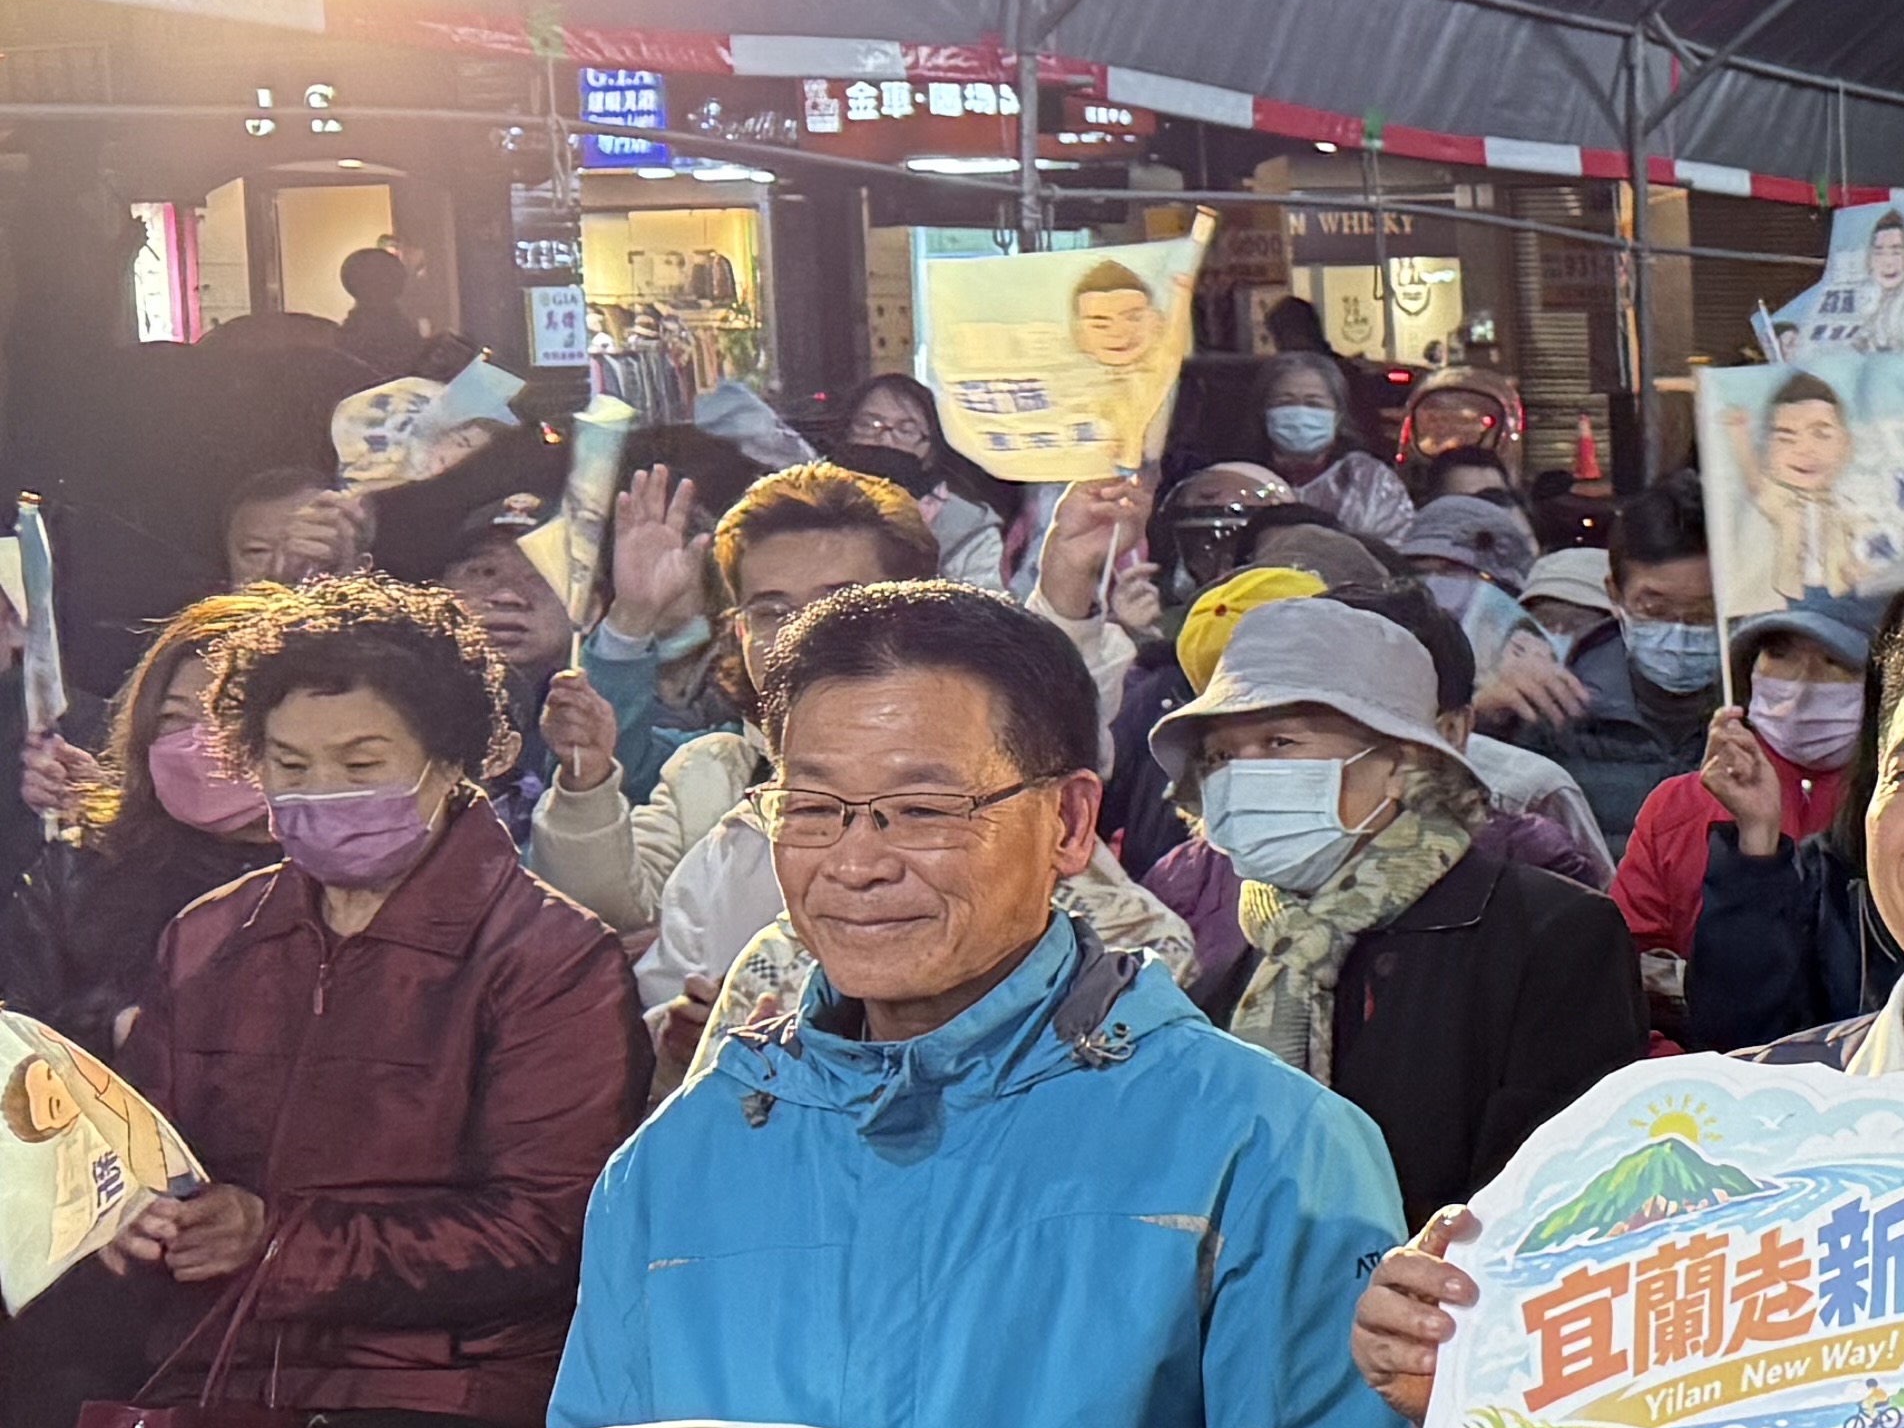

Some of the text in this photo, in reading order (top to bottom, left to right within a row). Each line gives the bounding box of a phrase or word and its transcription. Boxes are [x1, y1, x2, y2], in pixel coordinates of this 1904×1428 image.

[1319, 211, 1414, 236] WHIKY
[1642, 1328, 1899, 1426] Yilan New Way!
